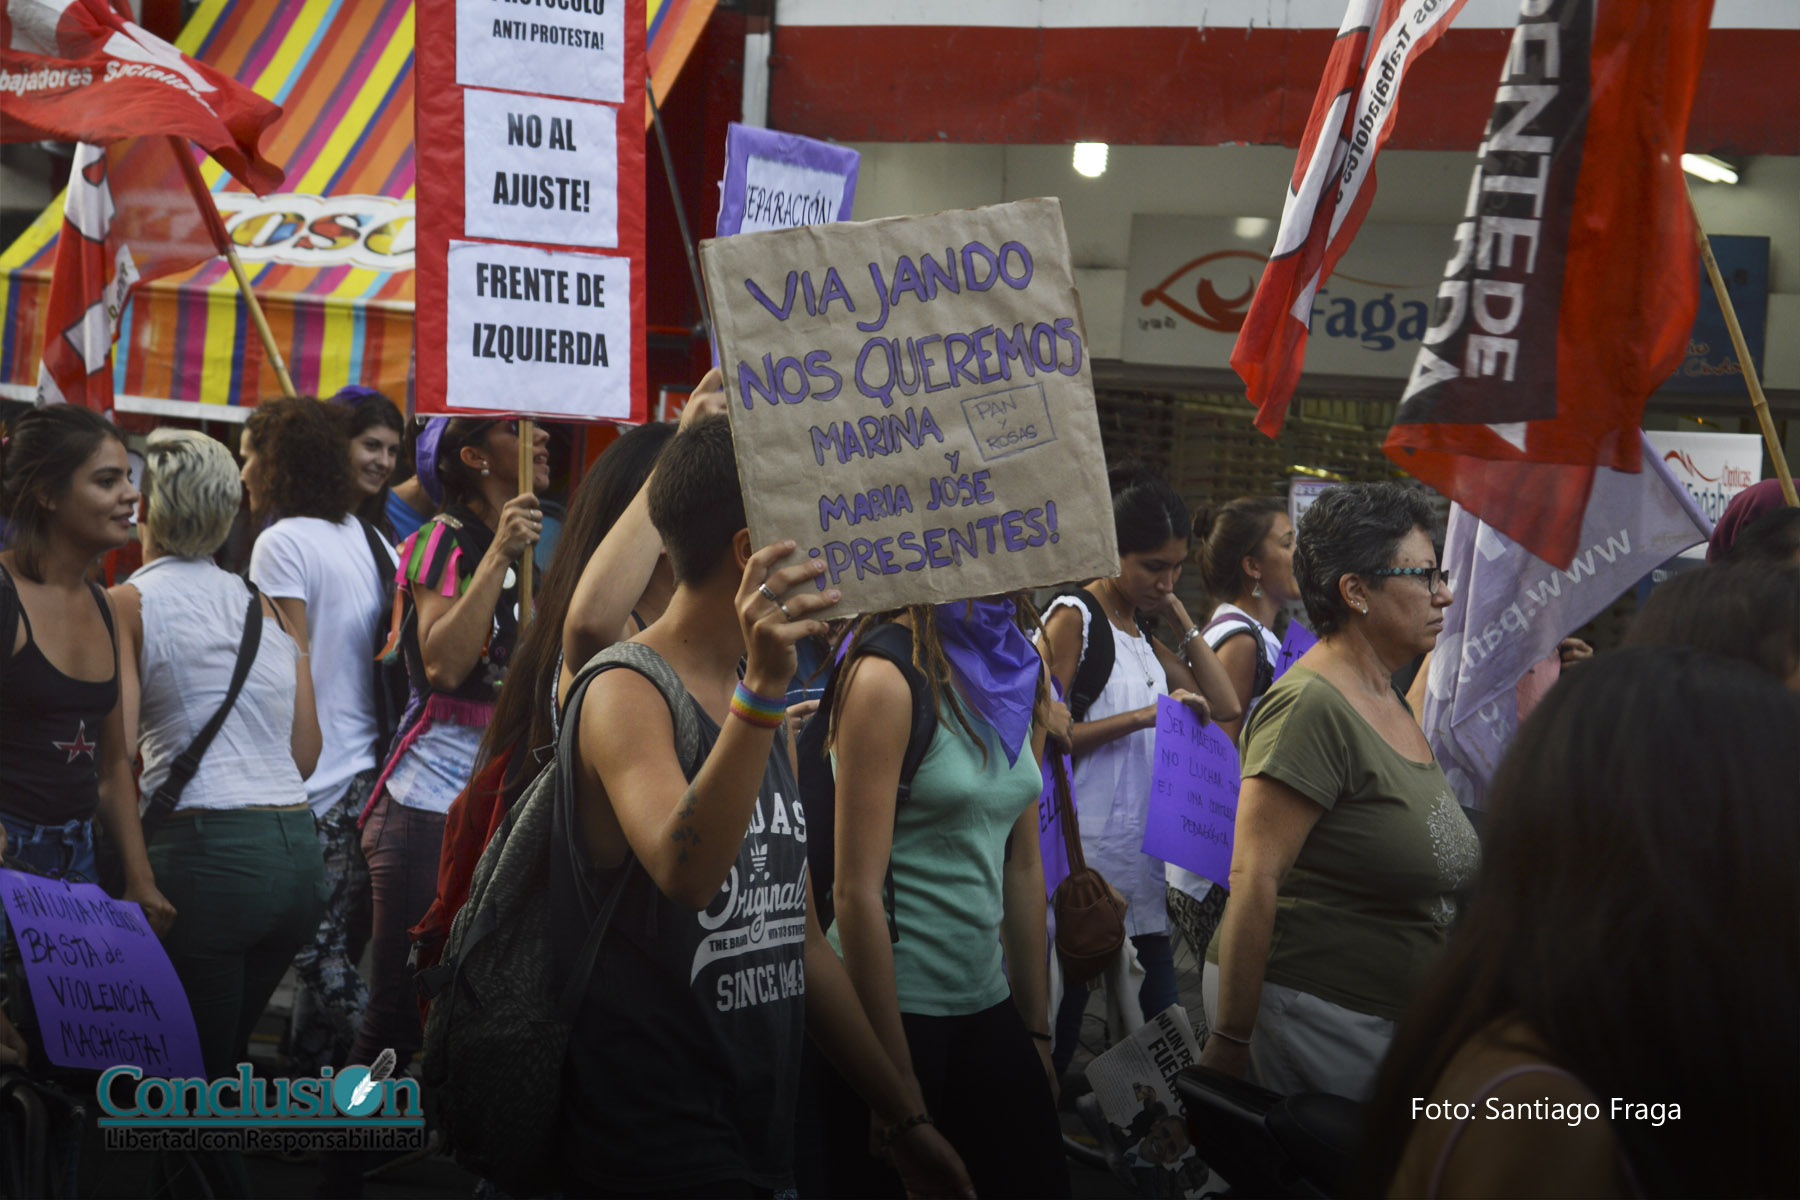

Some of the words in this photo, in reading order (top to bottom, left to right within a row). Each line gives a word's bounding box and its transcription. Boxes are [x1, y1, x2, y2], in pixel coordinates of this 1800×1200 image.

[492, 18, 527, 41] ANTI
[530, 23, 604, 51] PROTESTA!
[507, 112, 542, 149] NO
[549, 117, 577, 151] AL
[493, 171, 590, 213] AJUSTE!
[476, 262, 569, 304] FRENTE
[576, 272, 605, 308] DE
[472, 322, 609, 368] IZQUIERDA
[737, 350, 842, 410] NOS
[855, 317, 1083, 409] QUEREMOS
[973, 394, 1017, 420] PAN
[809, 406, 944, 466] MARINA
[986, 424, 1038, 450] ROSAS
[818, 484, 913, 532] MARIA
[1163, 704, 1186, 738] SER
[1161, 748, 1180, 768] NO
[1158, 779, 1174, 797] ES
[21, 928, 102, 968] BASTA
[102, 936, 124, 964] de
[708, 938, 728, 952] THE
[716, 963, 778, 1012] SINCE
